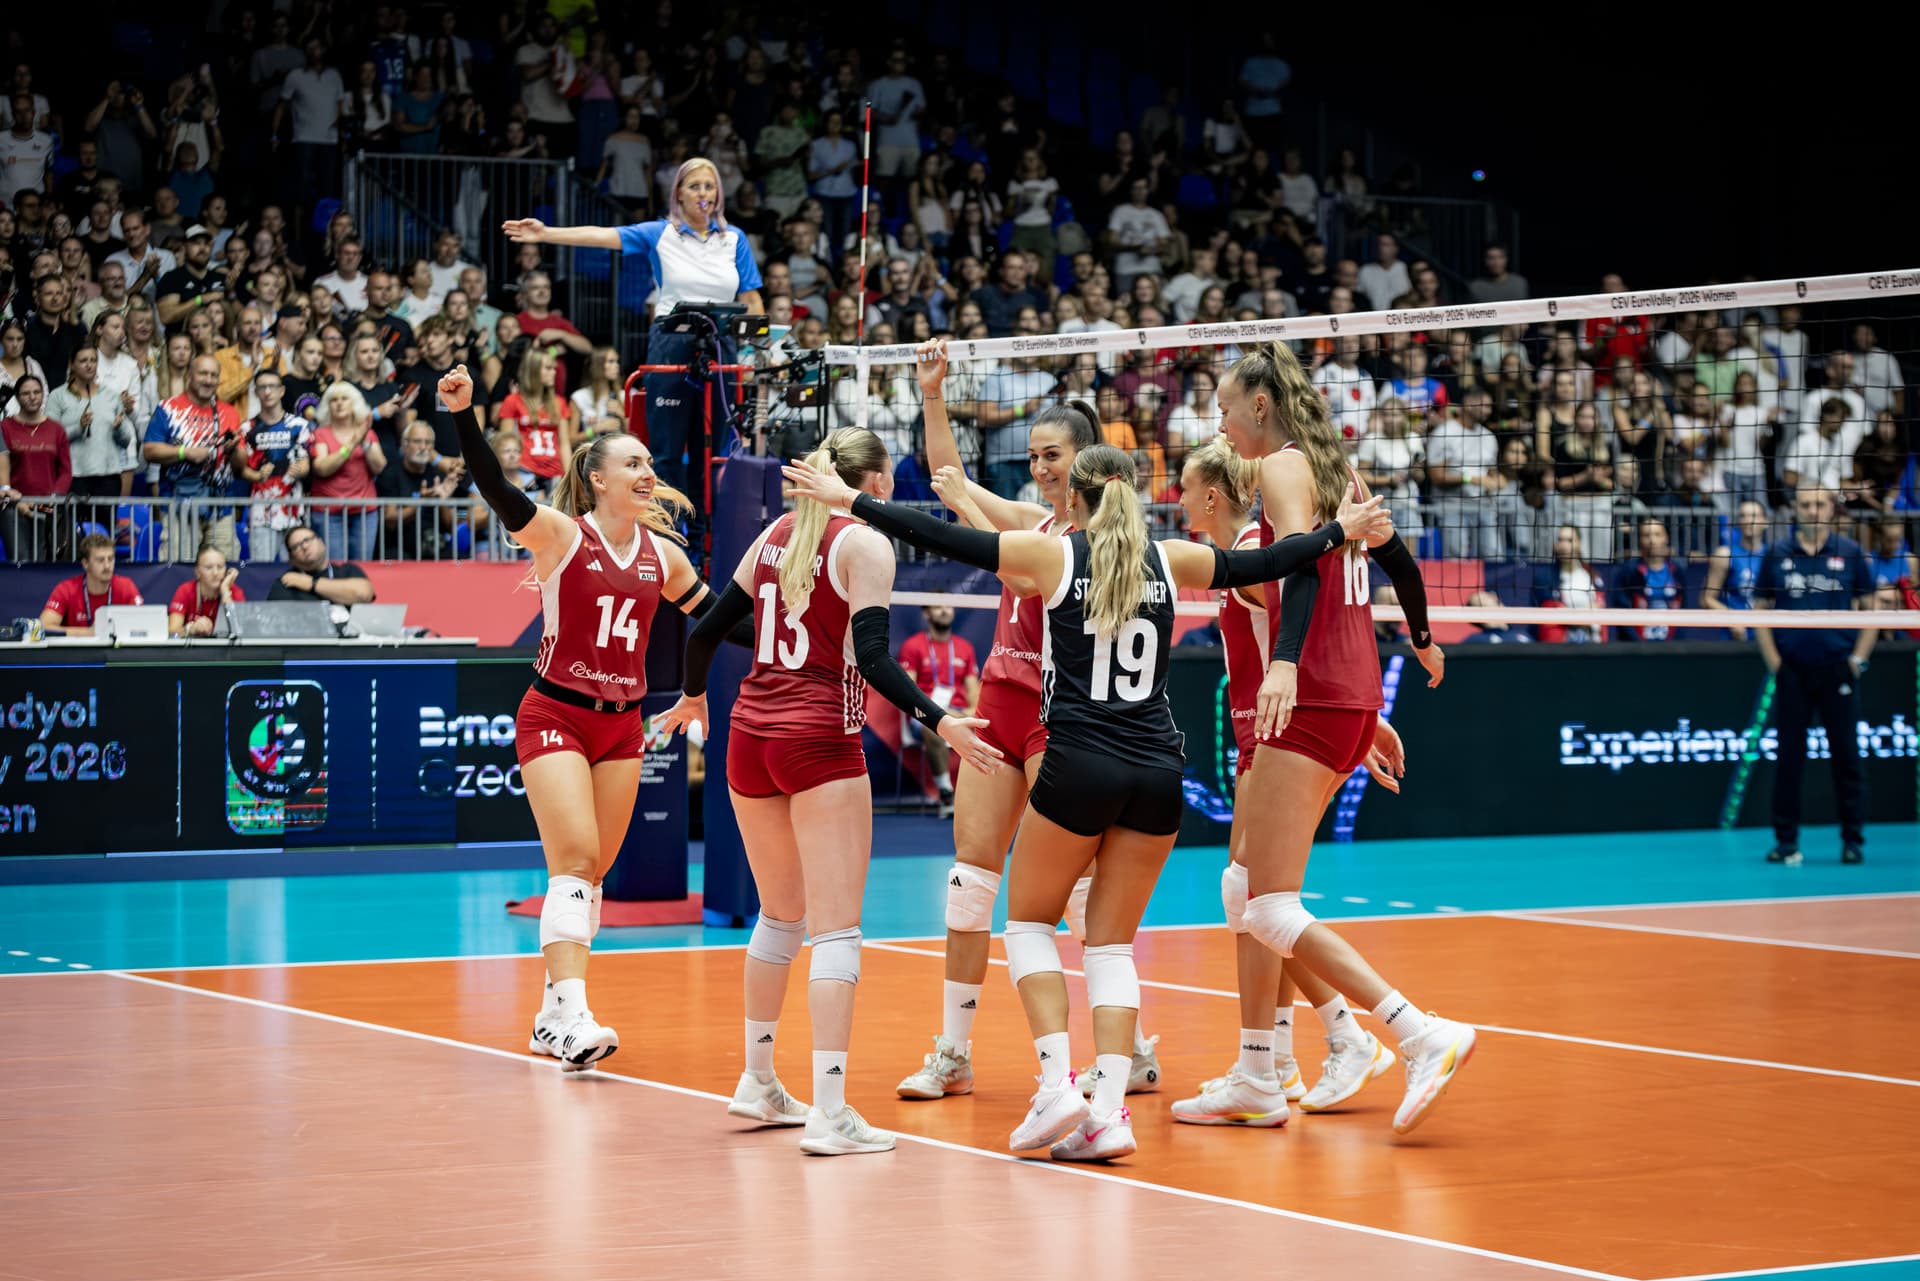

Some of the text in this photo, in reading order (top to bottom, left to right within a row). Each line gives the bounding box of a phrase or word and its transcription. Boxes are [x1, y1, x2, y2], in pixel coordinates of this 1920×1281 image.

[1869, 277, 1889, 290] CEV
[1611, 290, 1738, 309] CEV EuroVolley 2026 Women
[1188, 323, 1285, 339] CEV EuroVolley 2026 Women
[1386, 308, 1497, 325] CEV EuroVolley 2026 Women
[596, 595, 639, 652] 14
[758, 582, 809, 670] 13
[1083, 618, 1158, 702] 19
[420, 706, 516, 748] Brno
[540, 729, 563, 747] 14
[1560, 717, 1778, 772] Experience
[25, 741, 126, 782] 2026
[1242, 1044, 1271, 1052] adidas
